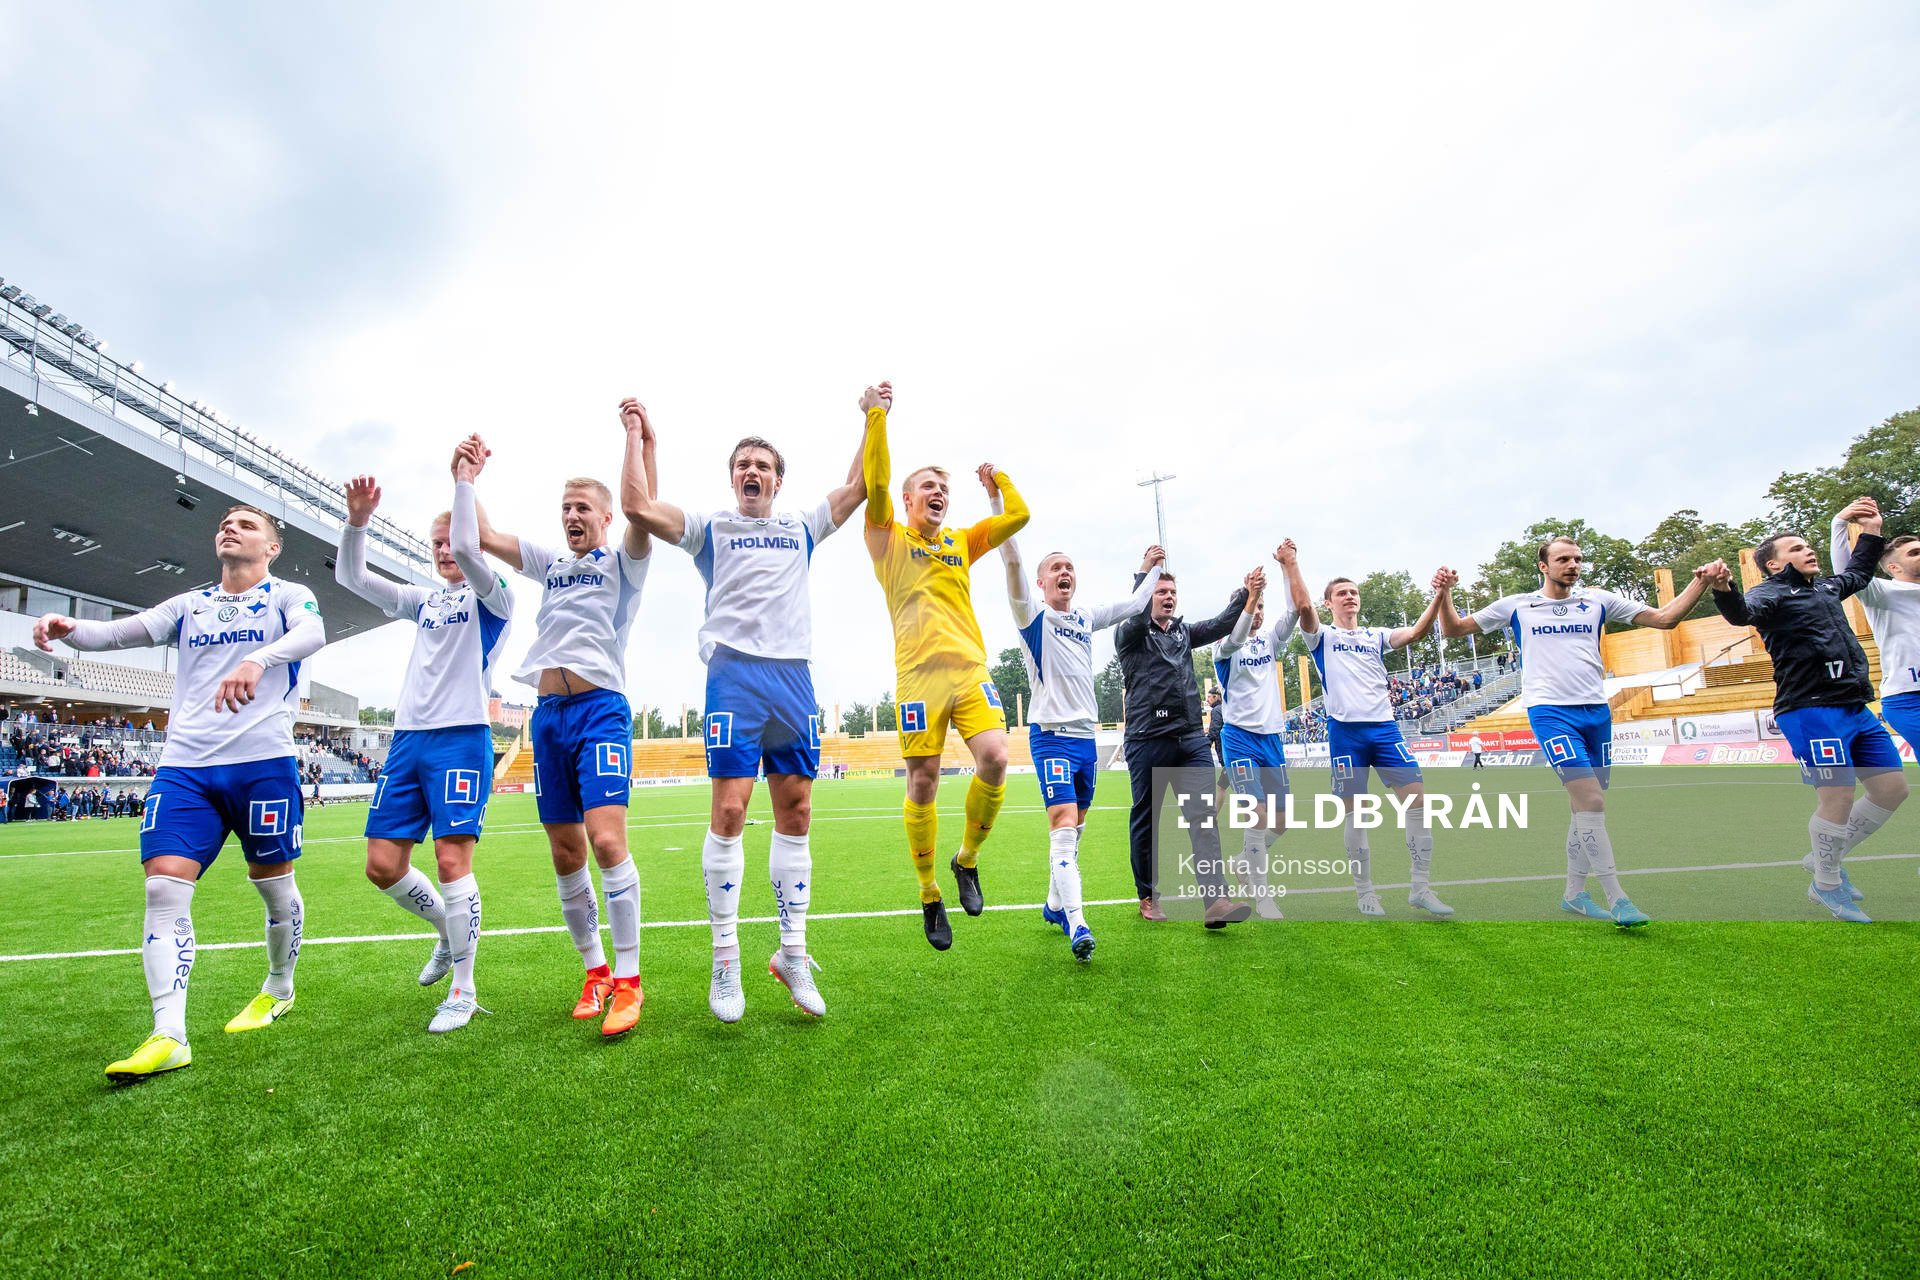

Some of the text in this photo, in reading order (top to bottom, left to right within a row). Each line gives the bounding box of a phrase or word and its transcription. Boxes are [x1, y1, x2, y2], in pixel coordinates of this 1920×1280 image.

[730, 536, 799, 550] HOLMEN
[1531, 624, 1593, 636] HOLMEN
[188, 629, 264, 648] HOLMEN
[1825, 660, 1844, 680] 17
[1908, 666, 1920, 683] 1
[1156, 709, 1168, 718] KH
[1652, 728, 1671, 737] TAK
[1451, 740, 1499, 748] TRANHAKT
[1479, 751, 1535, 766] stadium
[1710, 743, 1779, 764] Dumle
[1816, 768, 1833, 780] 10
[1047, 786, 1054, 798] 8
[173, 937, 195, 991] suez
